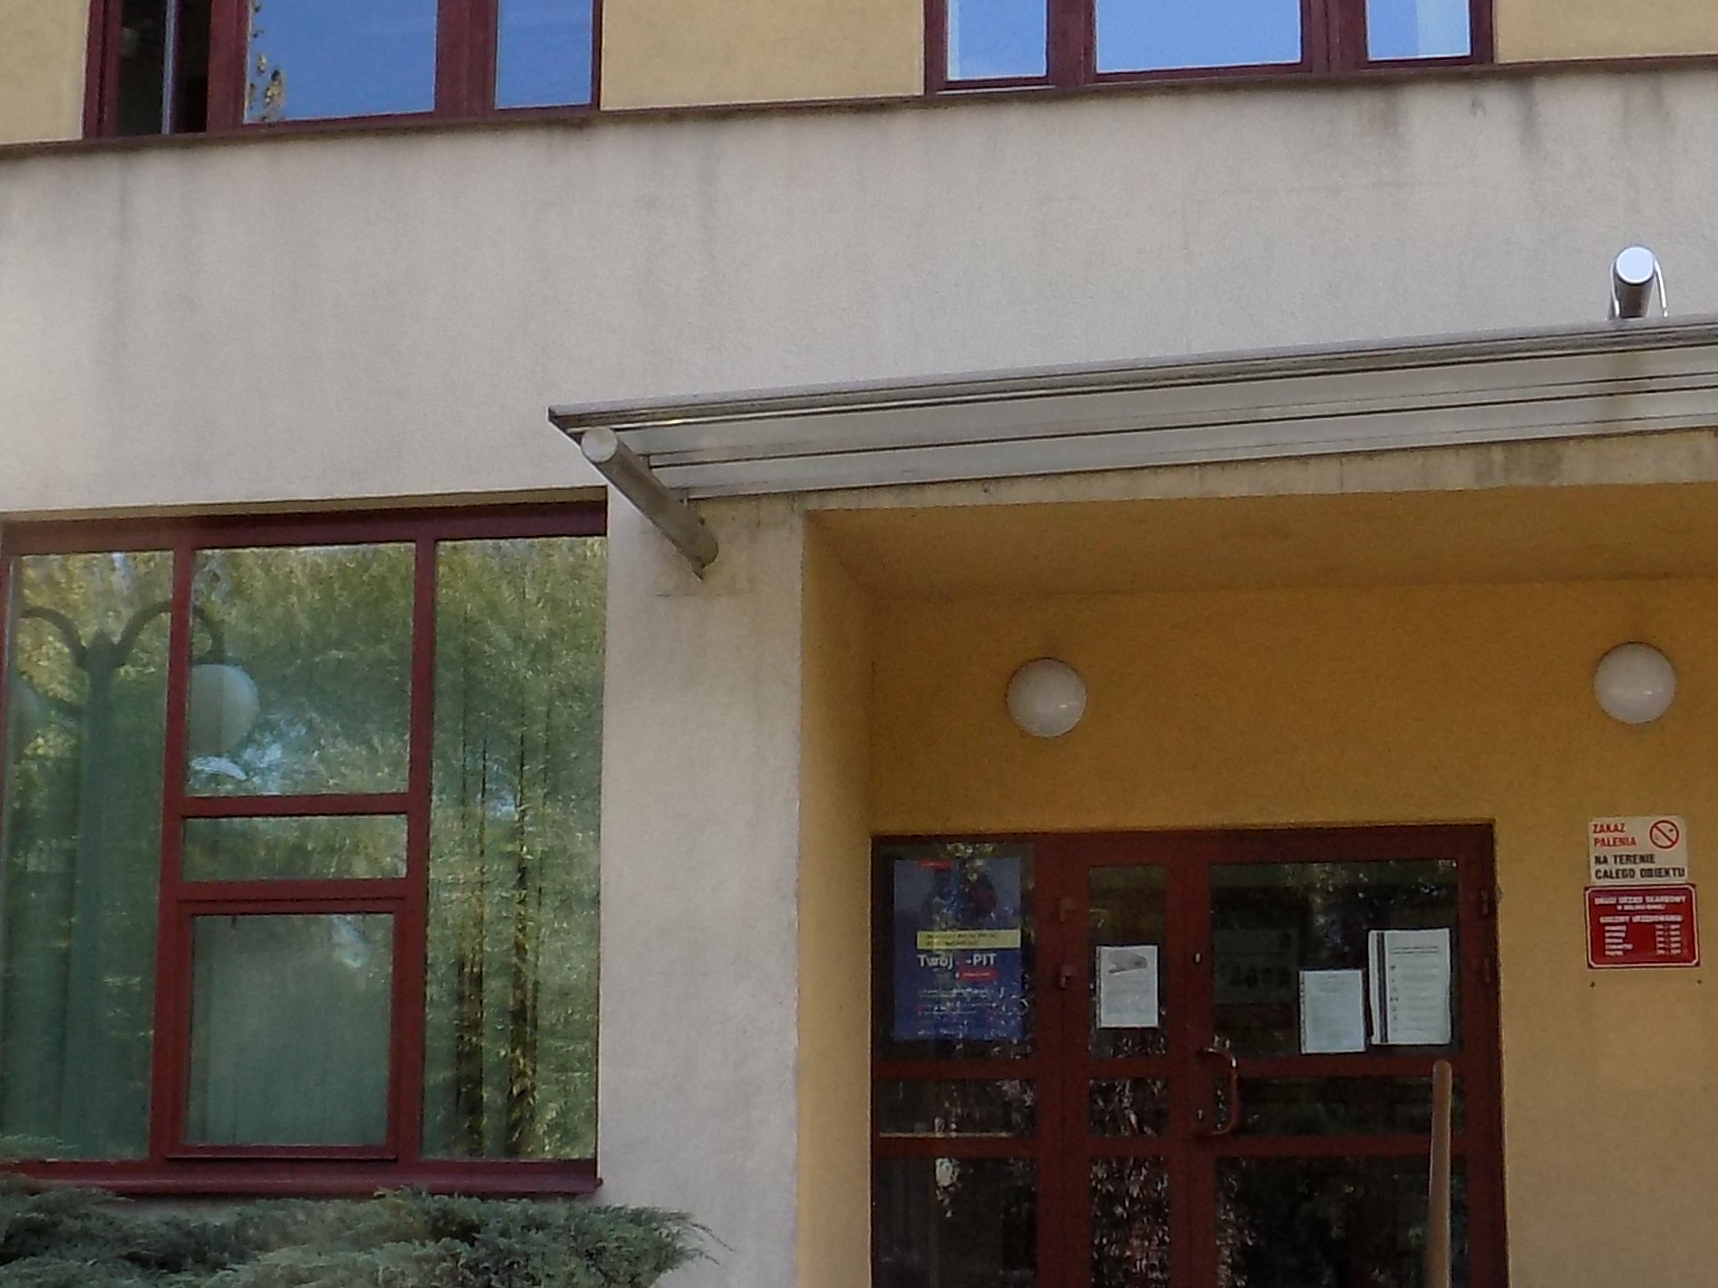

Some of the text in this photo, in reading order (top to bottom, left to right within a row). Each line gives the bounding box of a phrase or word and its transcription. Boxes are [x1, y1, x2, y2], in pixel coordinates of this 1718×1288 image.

[1592, 822, 1625, 834] ZAKAZ
[1593, 836, 1637, 847] PALENIA
[1594, 853, 1656, 865] NA TERENIE
[1639, 867, 1685, 878] OBIEKTU
